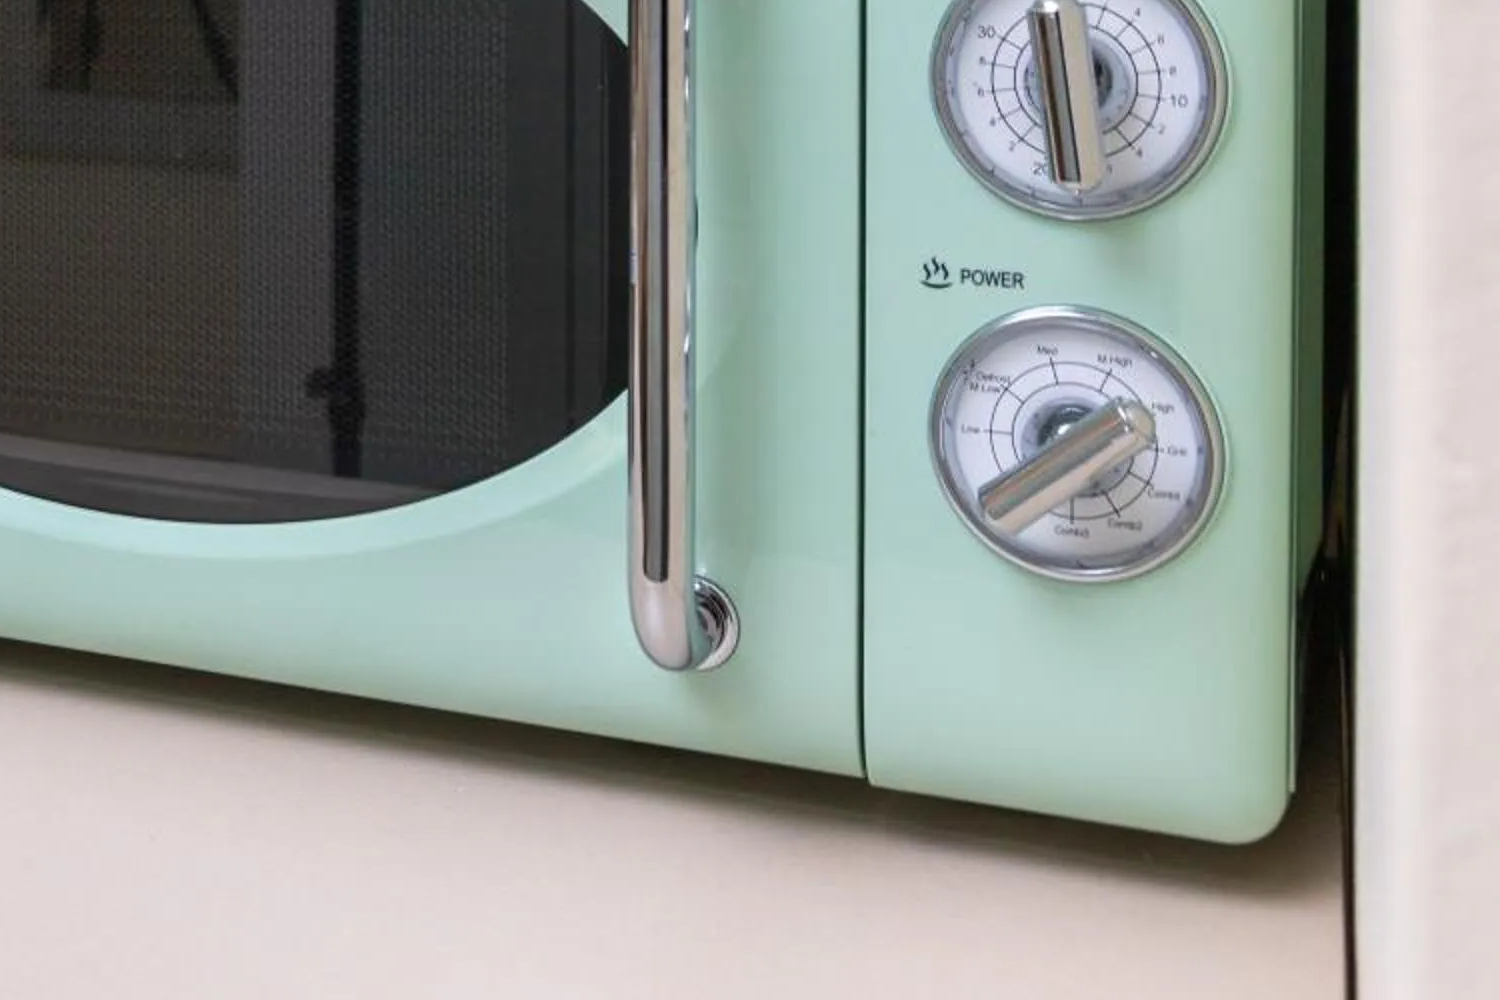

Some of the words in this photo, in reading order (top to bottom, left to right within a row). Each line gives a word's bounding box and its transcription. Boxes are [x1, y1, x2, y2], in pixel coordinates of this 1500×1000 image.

[977, 26, 996, 39] 30
[1171, 95, 1188, 108] 10
[960, 268, 1025, 290] POWER
